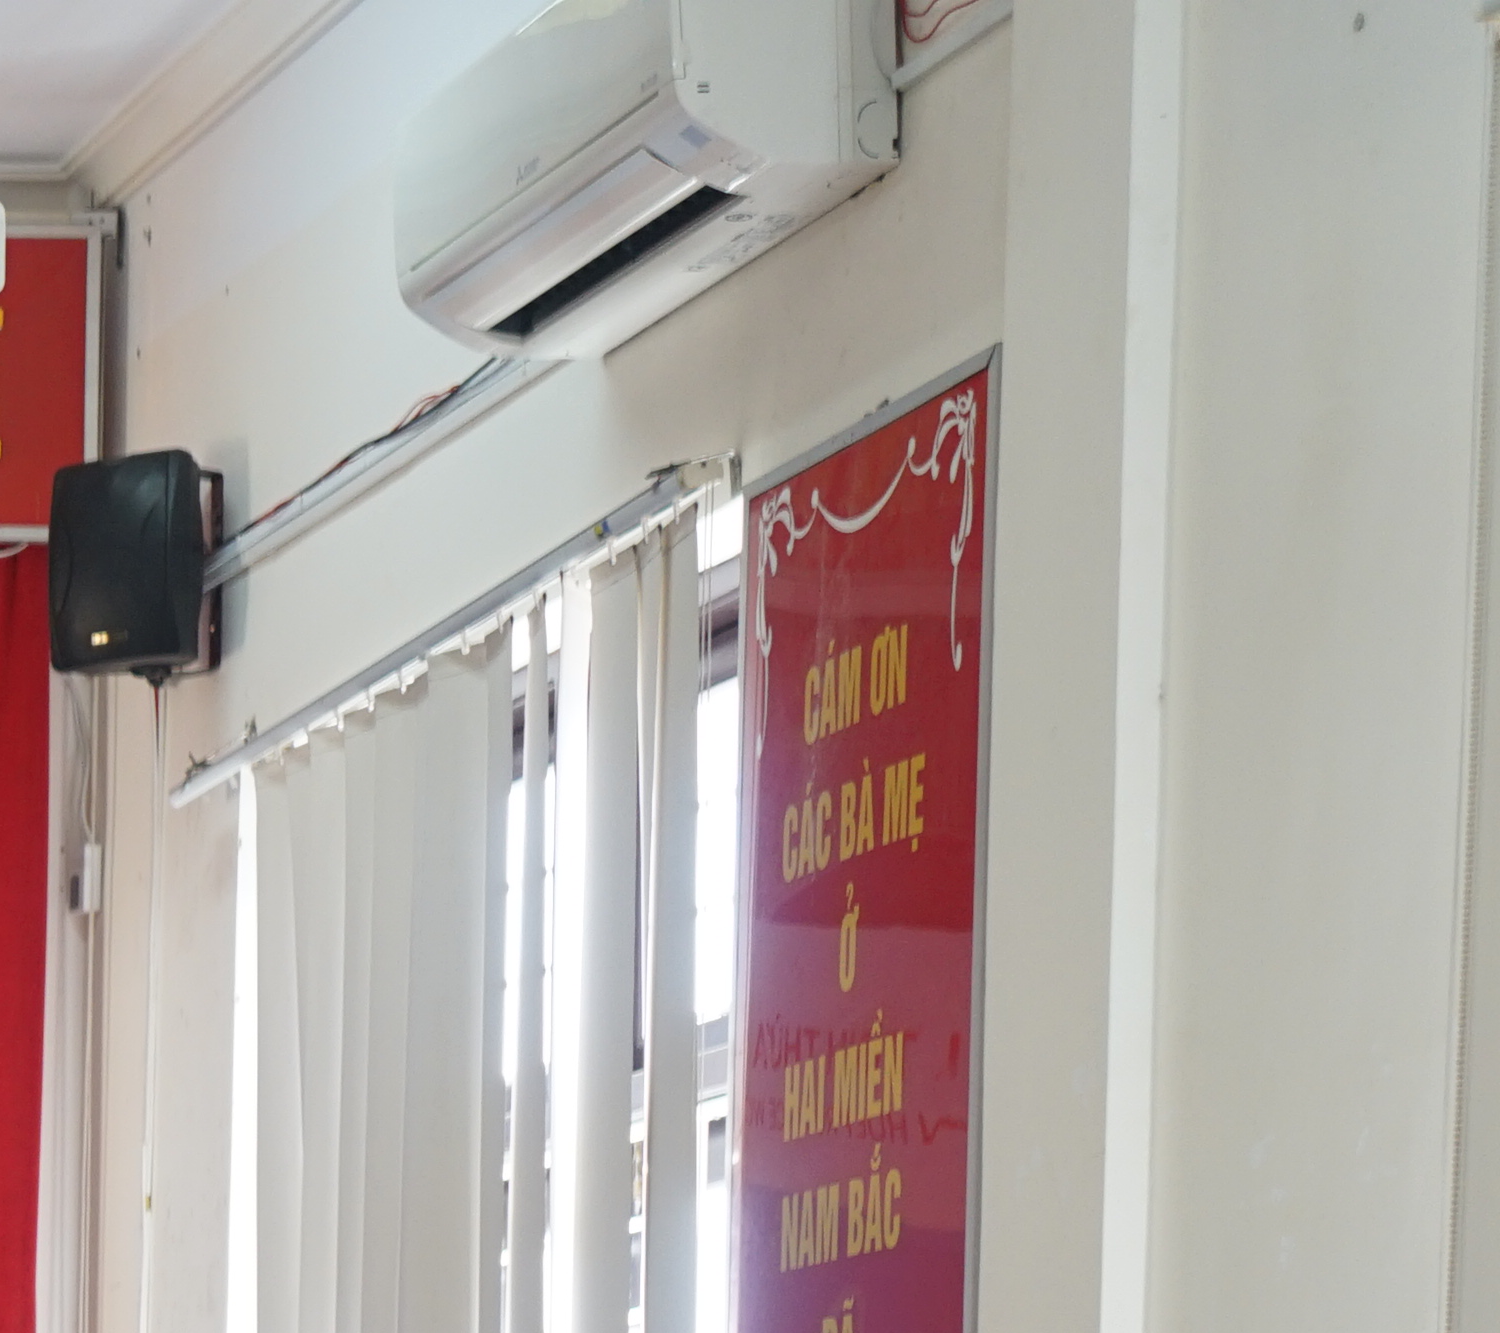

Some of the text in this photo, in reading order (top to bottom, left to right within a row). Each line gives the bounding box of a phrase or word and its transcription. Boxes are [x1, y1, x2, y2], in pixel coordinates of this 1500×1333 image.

[803, 623, 908, 746] CÁM ƠN
[783, 752, 926, 883] CÁC BÀ MẸ
[838, 882, 860, 993] Ở
[784, 1009, 904, 1142] HAI MIỀN
[780, 1143, 902, 1273] NAM BẮC
